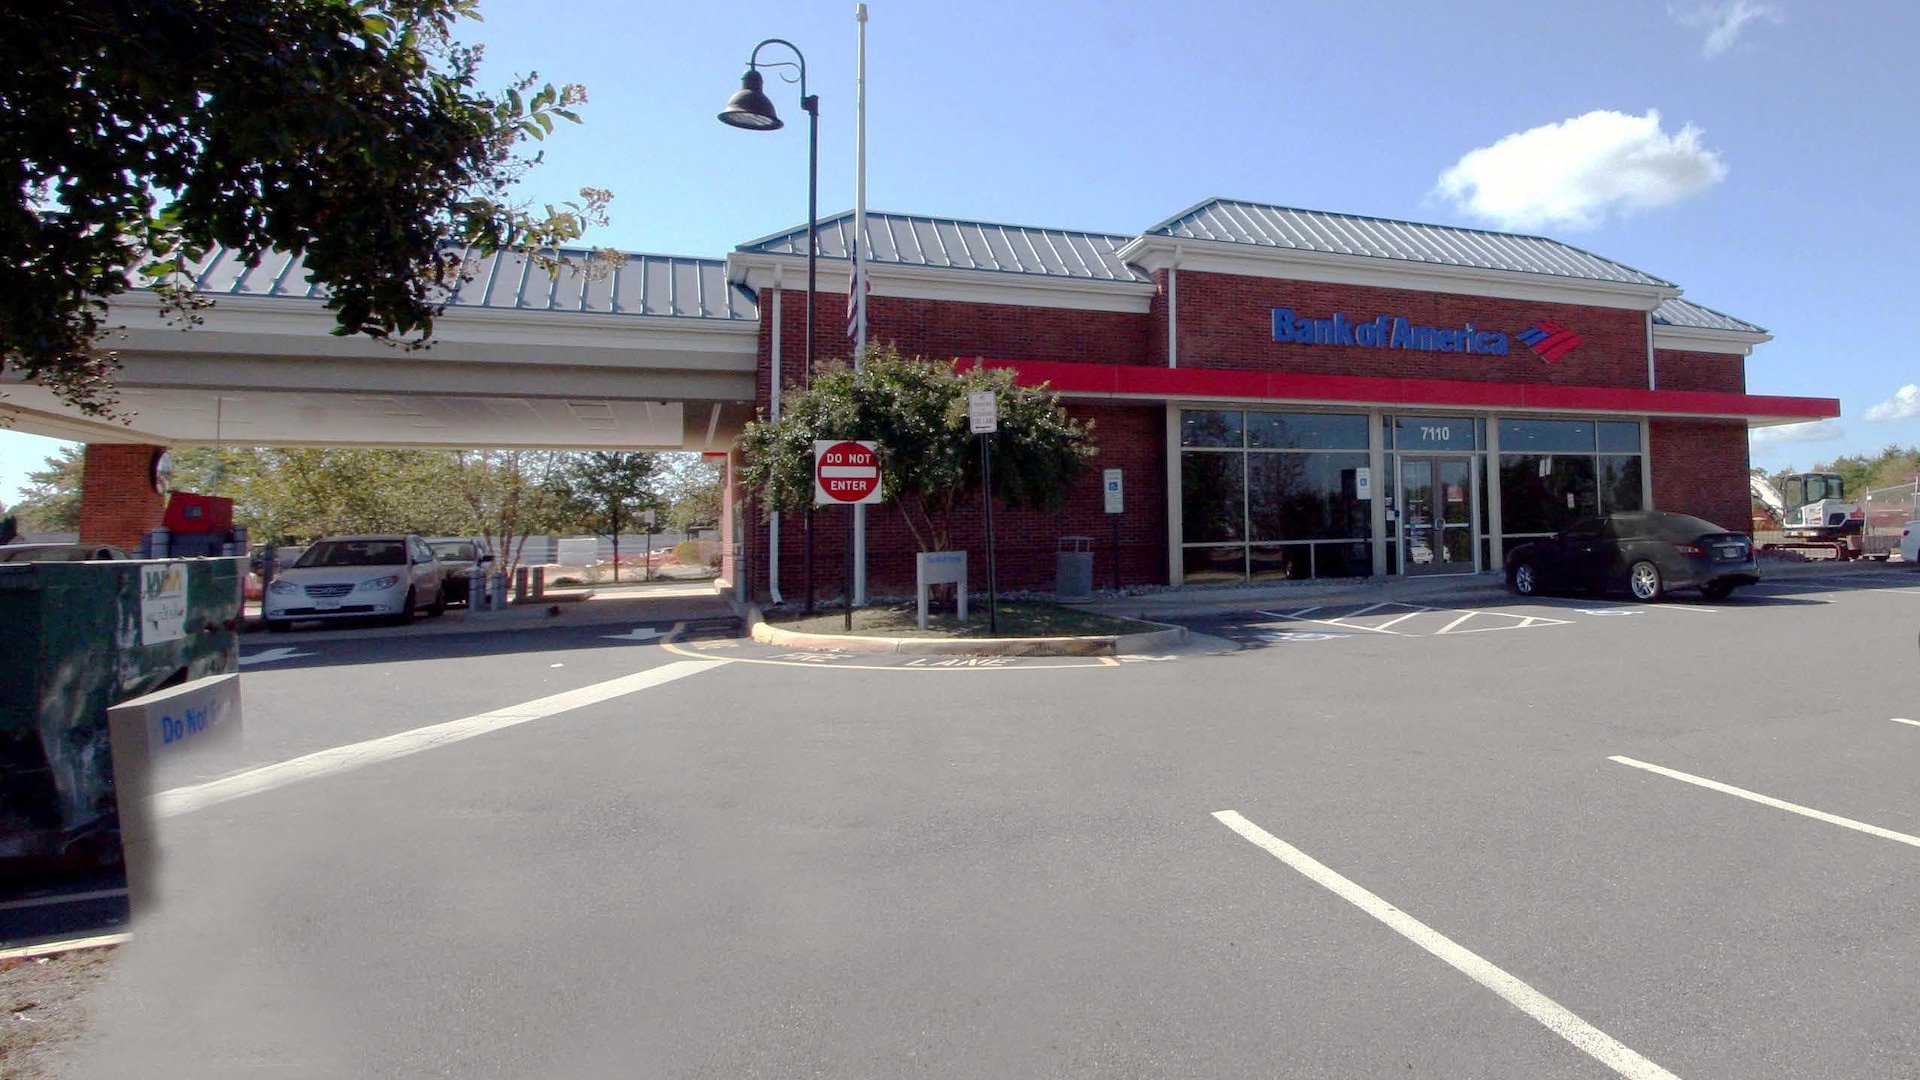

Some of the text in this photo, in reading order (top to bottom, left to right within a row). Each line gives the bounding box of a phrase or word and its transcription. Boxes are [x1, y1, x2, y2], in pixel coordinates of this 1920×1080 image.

[1272, 307, 1508, 356] Bank of America
[1420, 426, 1450, 441] 7110
[826, 453, 871, 464] DO NOT
[830, 480, 867, 491] ENTER
[162, 715, 183, 744] Do
